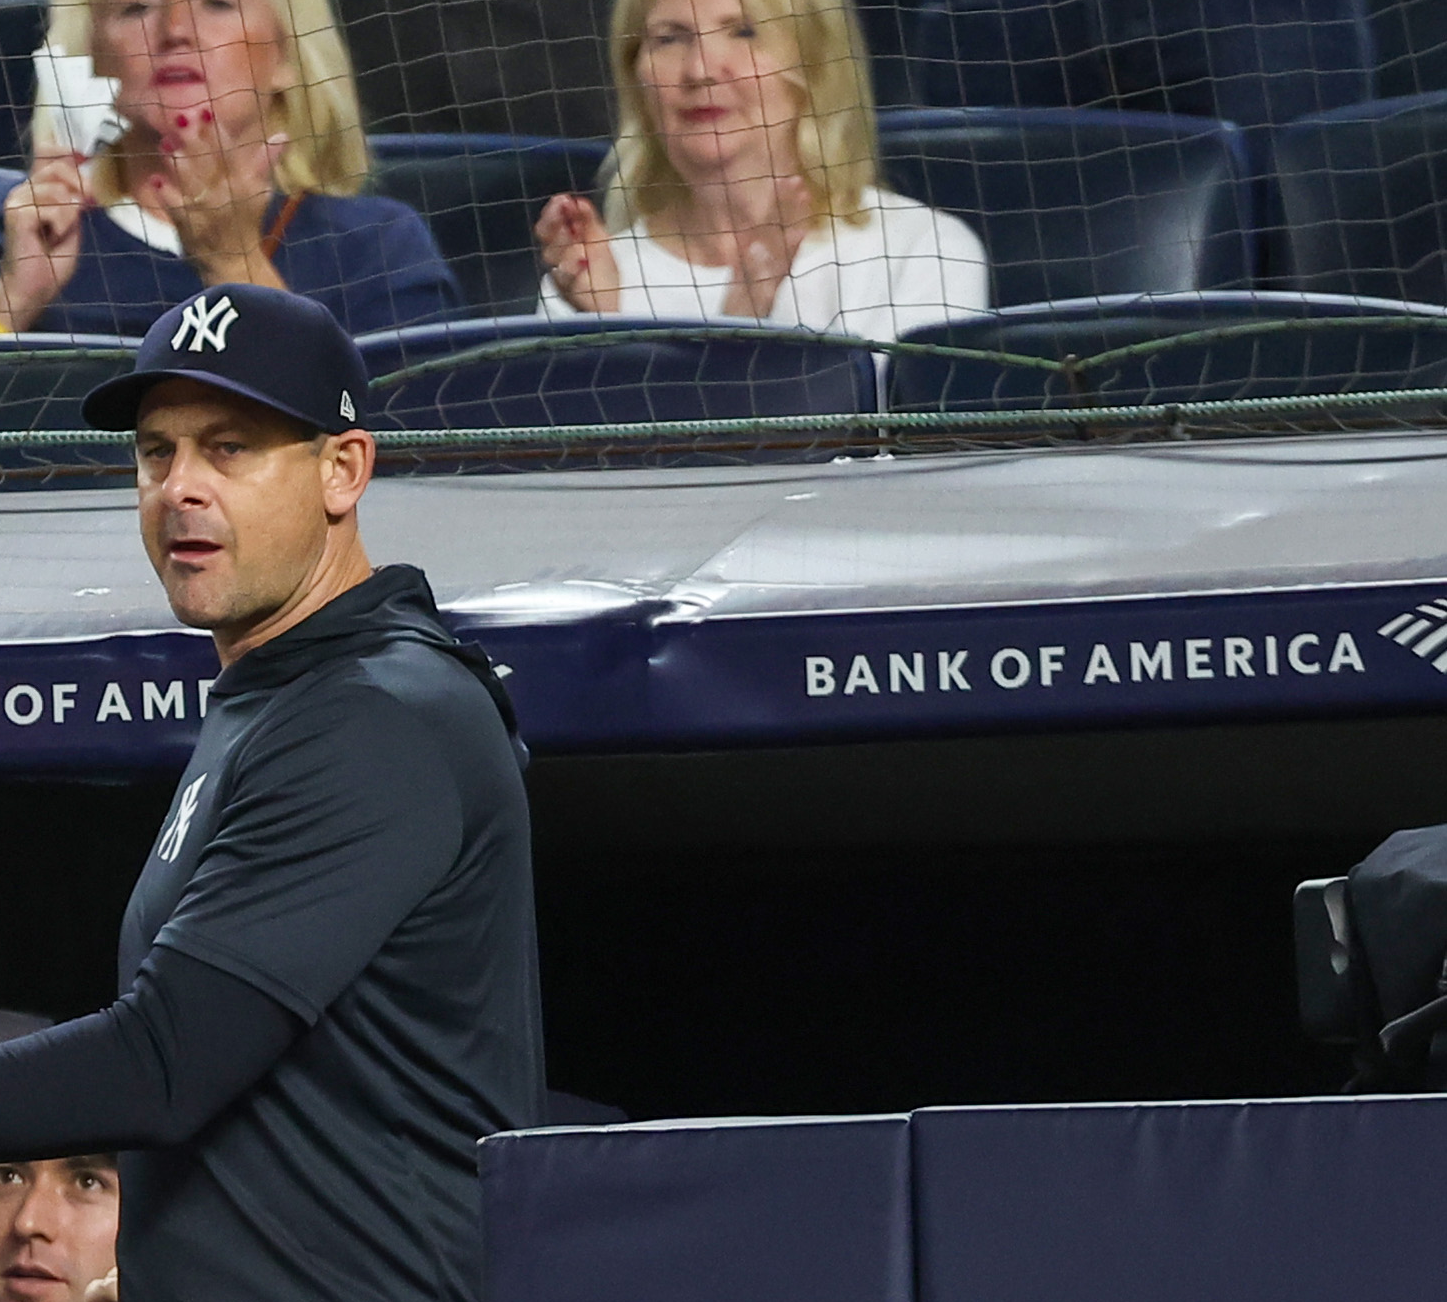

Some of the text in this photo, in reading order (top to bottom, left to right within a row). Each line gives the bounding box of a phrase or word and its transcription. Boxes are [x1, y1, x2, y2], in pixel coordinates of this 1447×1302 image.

[171, 295, 240, 353] NY
[805, 632, 1365, 697] BANK OF AMERICA
[4, 683, 79, 726] OF
